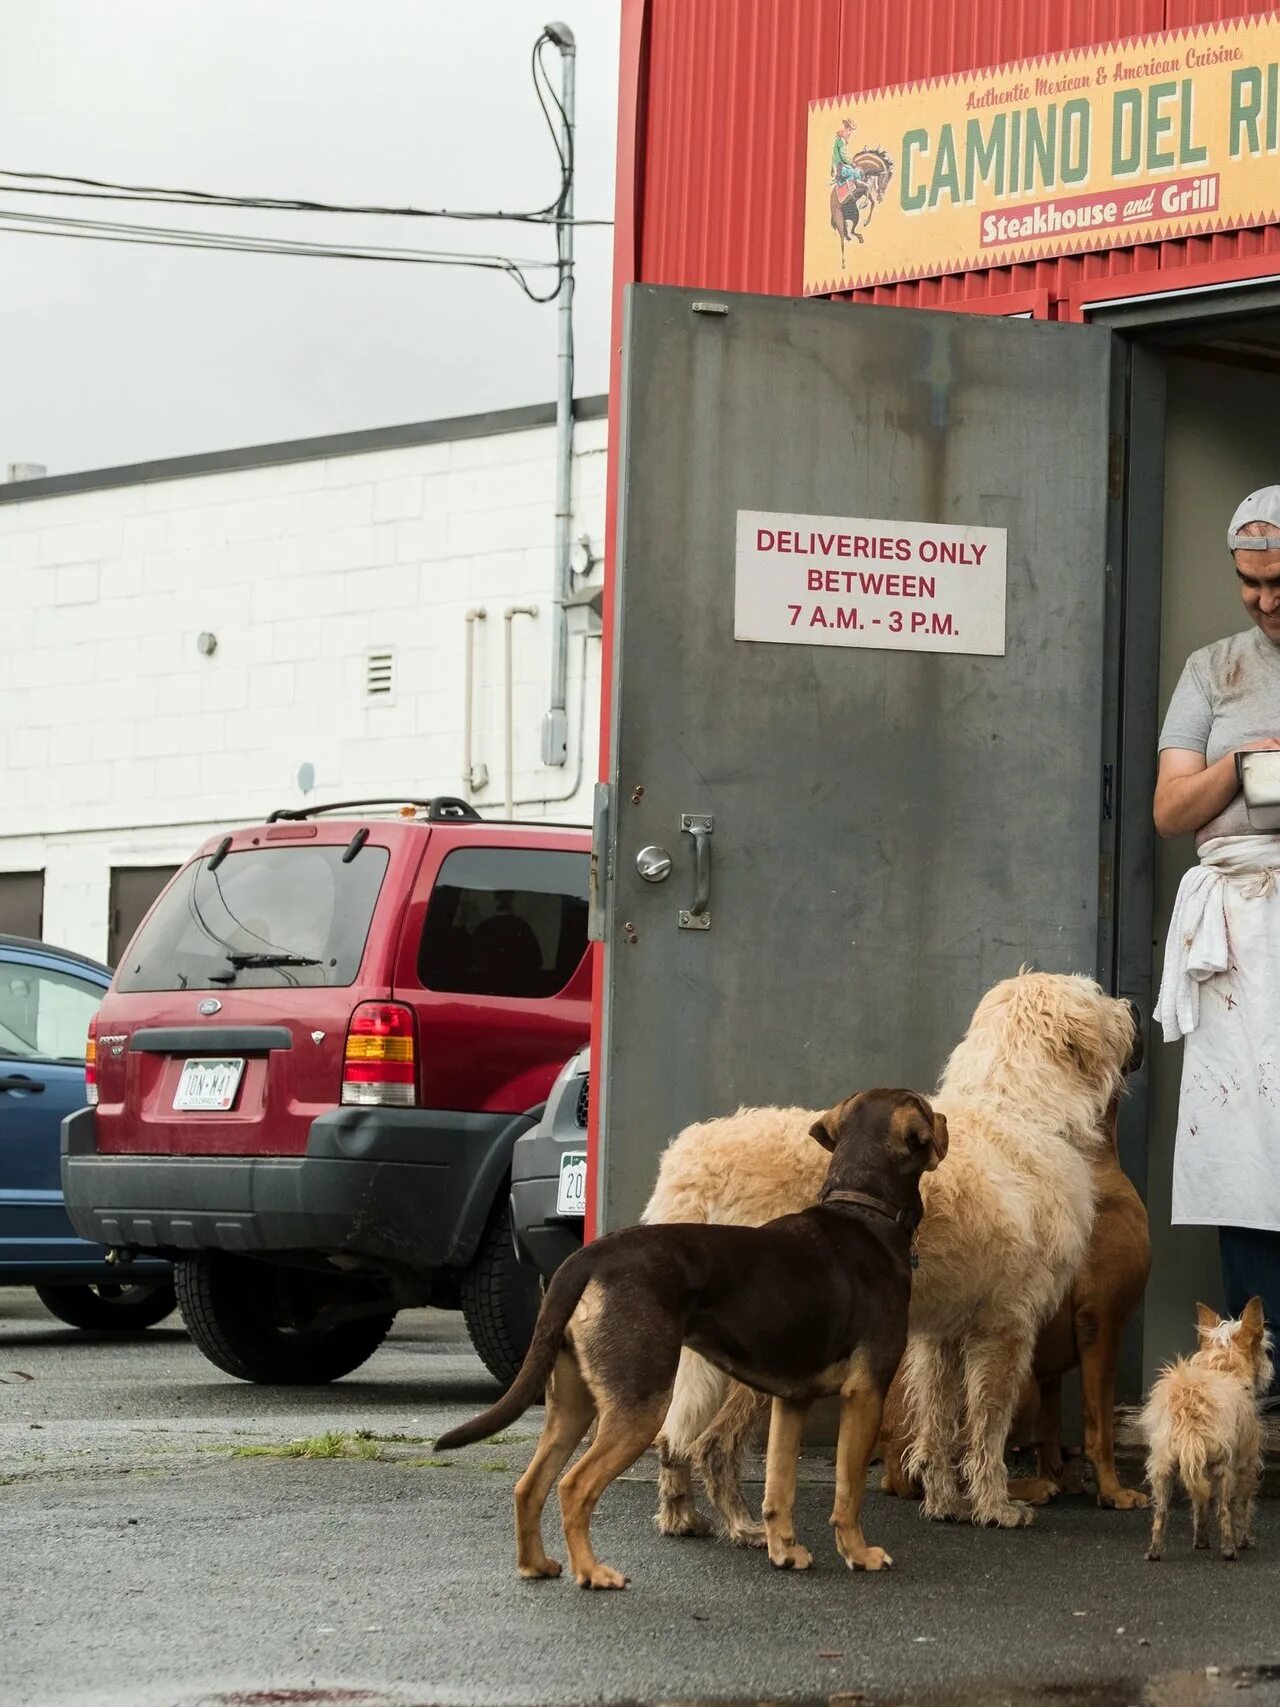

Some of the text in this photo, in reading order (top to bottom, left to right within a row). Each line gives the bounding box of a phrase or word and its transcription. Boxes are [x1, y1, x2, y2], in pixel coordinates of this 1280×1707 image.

[966, 44, 1243, 111] Authentic Mexican & American Cuisine
[899, 97, 1092, 213] CAMINO
[1111, 78, 1207, 179] DEL
[983, 177, 1217, 243] Steakhouse and Grill
[756, 529, 987, 566] DELIVERIES ONLY
[807, 569, 935, 598] BETWEEN
[787, 604, 802, 626] 7
[809, 605, 864, 630] A.M.
[888, 610, 903, 633] 3
[911, 612, 960, 636] P.M.
